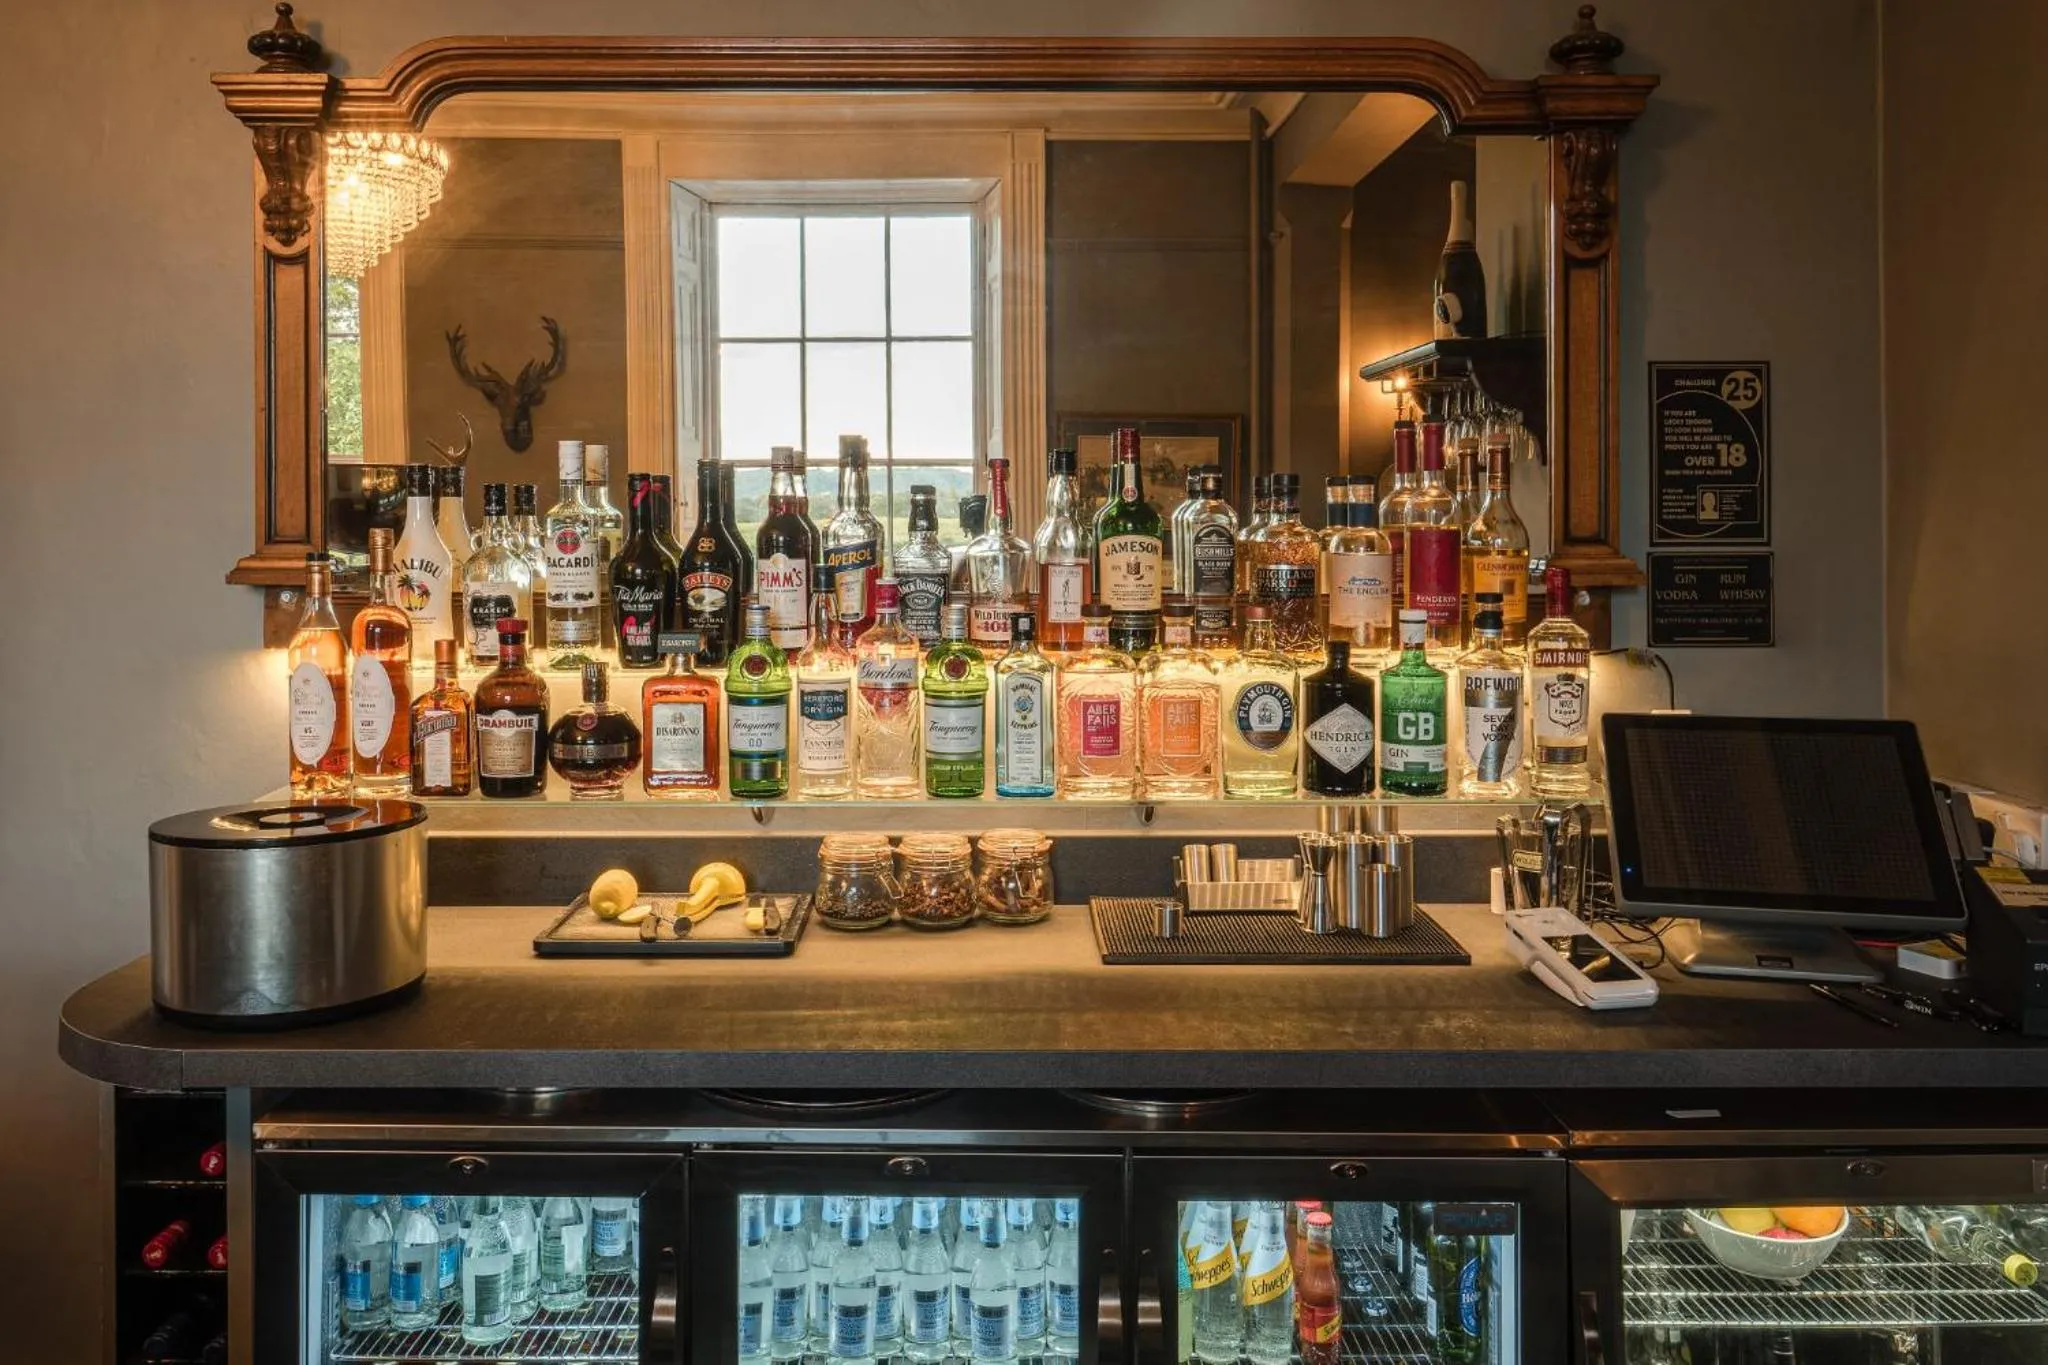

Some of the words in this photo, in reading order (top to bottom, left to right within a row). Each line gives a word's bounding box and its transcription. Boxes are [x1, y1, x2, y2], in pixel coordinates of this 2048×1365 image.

[1725, 377, 1758, 402] 25
[1684, 456, 1715, 467] OVER
[1717, 443, 1747, 468] 18
[1105, 541, 1159, 558] JAMESON
[828, 548, 873, 567] APEROL
[760, 567, 804, 588] PIMM'S
[1257, 569, 1314, 579] HIGHLAND
[1675, 573, 1697, 584] GIN
[1720, 573, 1746, 584] RUM
[613, 585, 631, 601] Tia
[630, 585, 663, 602] Maria
[1338, 586, 1353, 595] THE
[1655, 590, 1699, 600] VODKA
[1719, 589, 1767, 600] WHISKY
[1416, 594, 1456, 603] PENDERYN
[983, 620, 1009, 632] 101
[1535, 651, 1586, 664] SMIRNOF
[861, 661, 912, 680] Gordon's
[1466, 676, 1523, 692] BREWDO
[1239, 684, 1284, 718] PLYMOUTH
[1281, 697, 1291, 717] GIN
[1087, 703, 1117, 715] ABER
[479, 718, 534, 728] DRAMBUIE
[1483, 714, 1515, 723] SEVEN
[656, 727, 700, 737] DISARONNO
[733, 719, 781, 733] Tanqueray
[929, 720, 977, 737] Tanqueray
[1398, 712, 1435, 741] GB
[1490, 723, 1509, 732] DAY
[1310, 731, 1370, 742] HENDRICK
[1482, 732, 1515, 742] VODKA
[1389, 747, 1409, 758] GIN
[1195, 1257, 1232, 1284] hweppes
[1251, 1266, 1292, 1298] Schwepp
